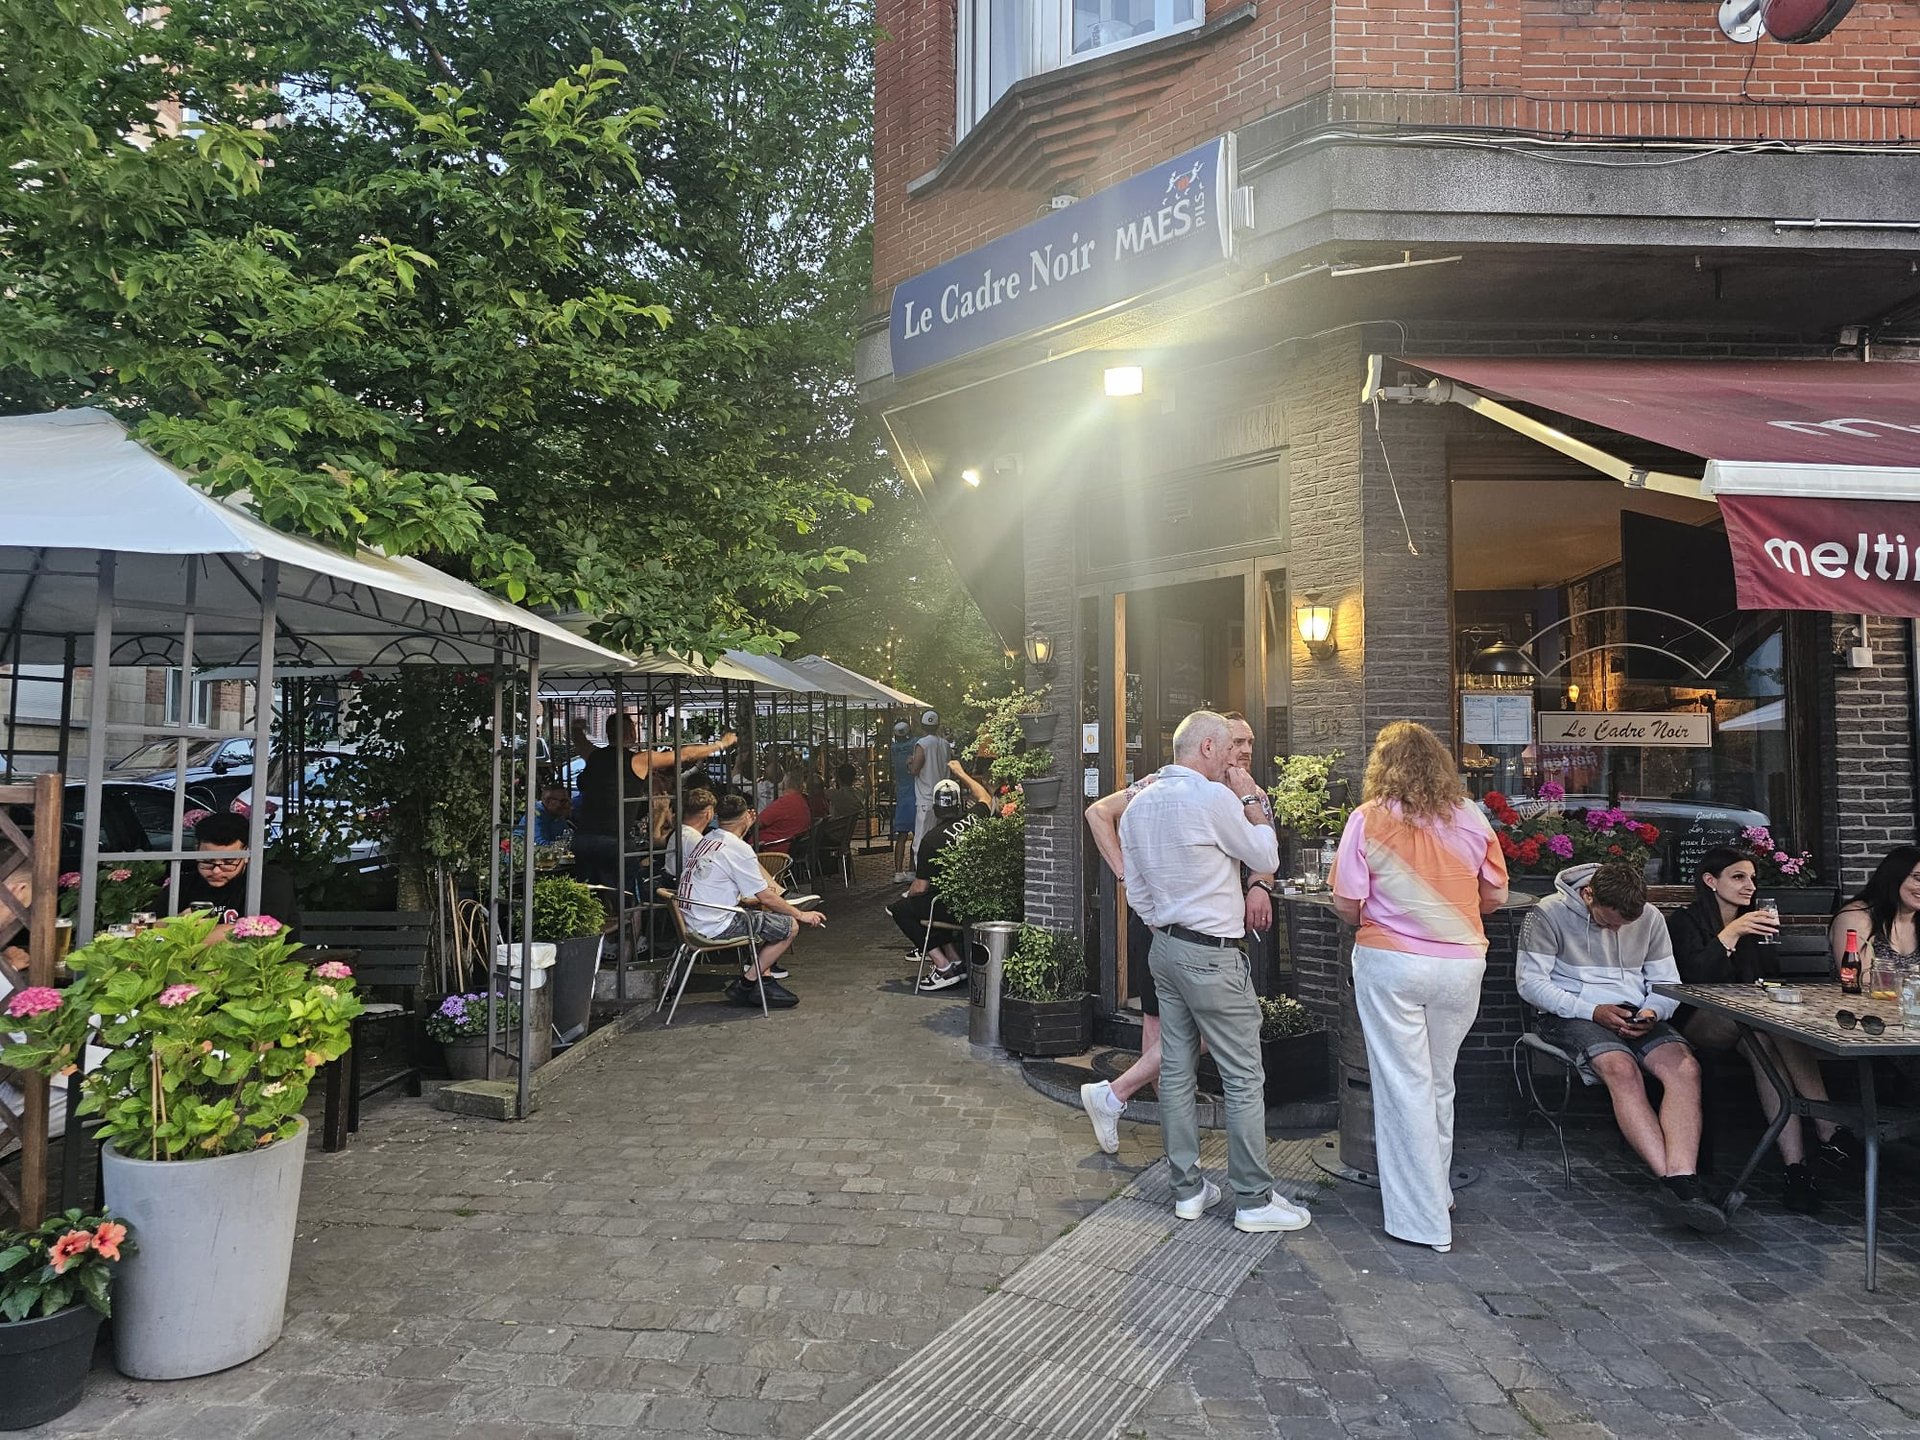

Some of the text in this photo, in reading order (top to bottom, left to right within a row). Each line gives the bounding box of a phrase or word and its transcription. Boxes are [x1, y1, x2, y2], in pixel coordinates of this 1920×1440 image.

[1115, 199, 1191, 261] MAES
[903, 301, 932, 340] Le
[940, 269, 1020, 325] Cadre
[1029, 232, 1095, 292] Noir
[1763, 533, 1920, 581] melti
[1561, 720, 1689, 740] Le Cadre Noir
